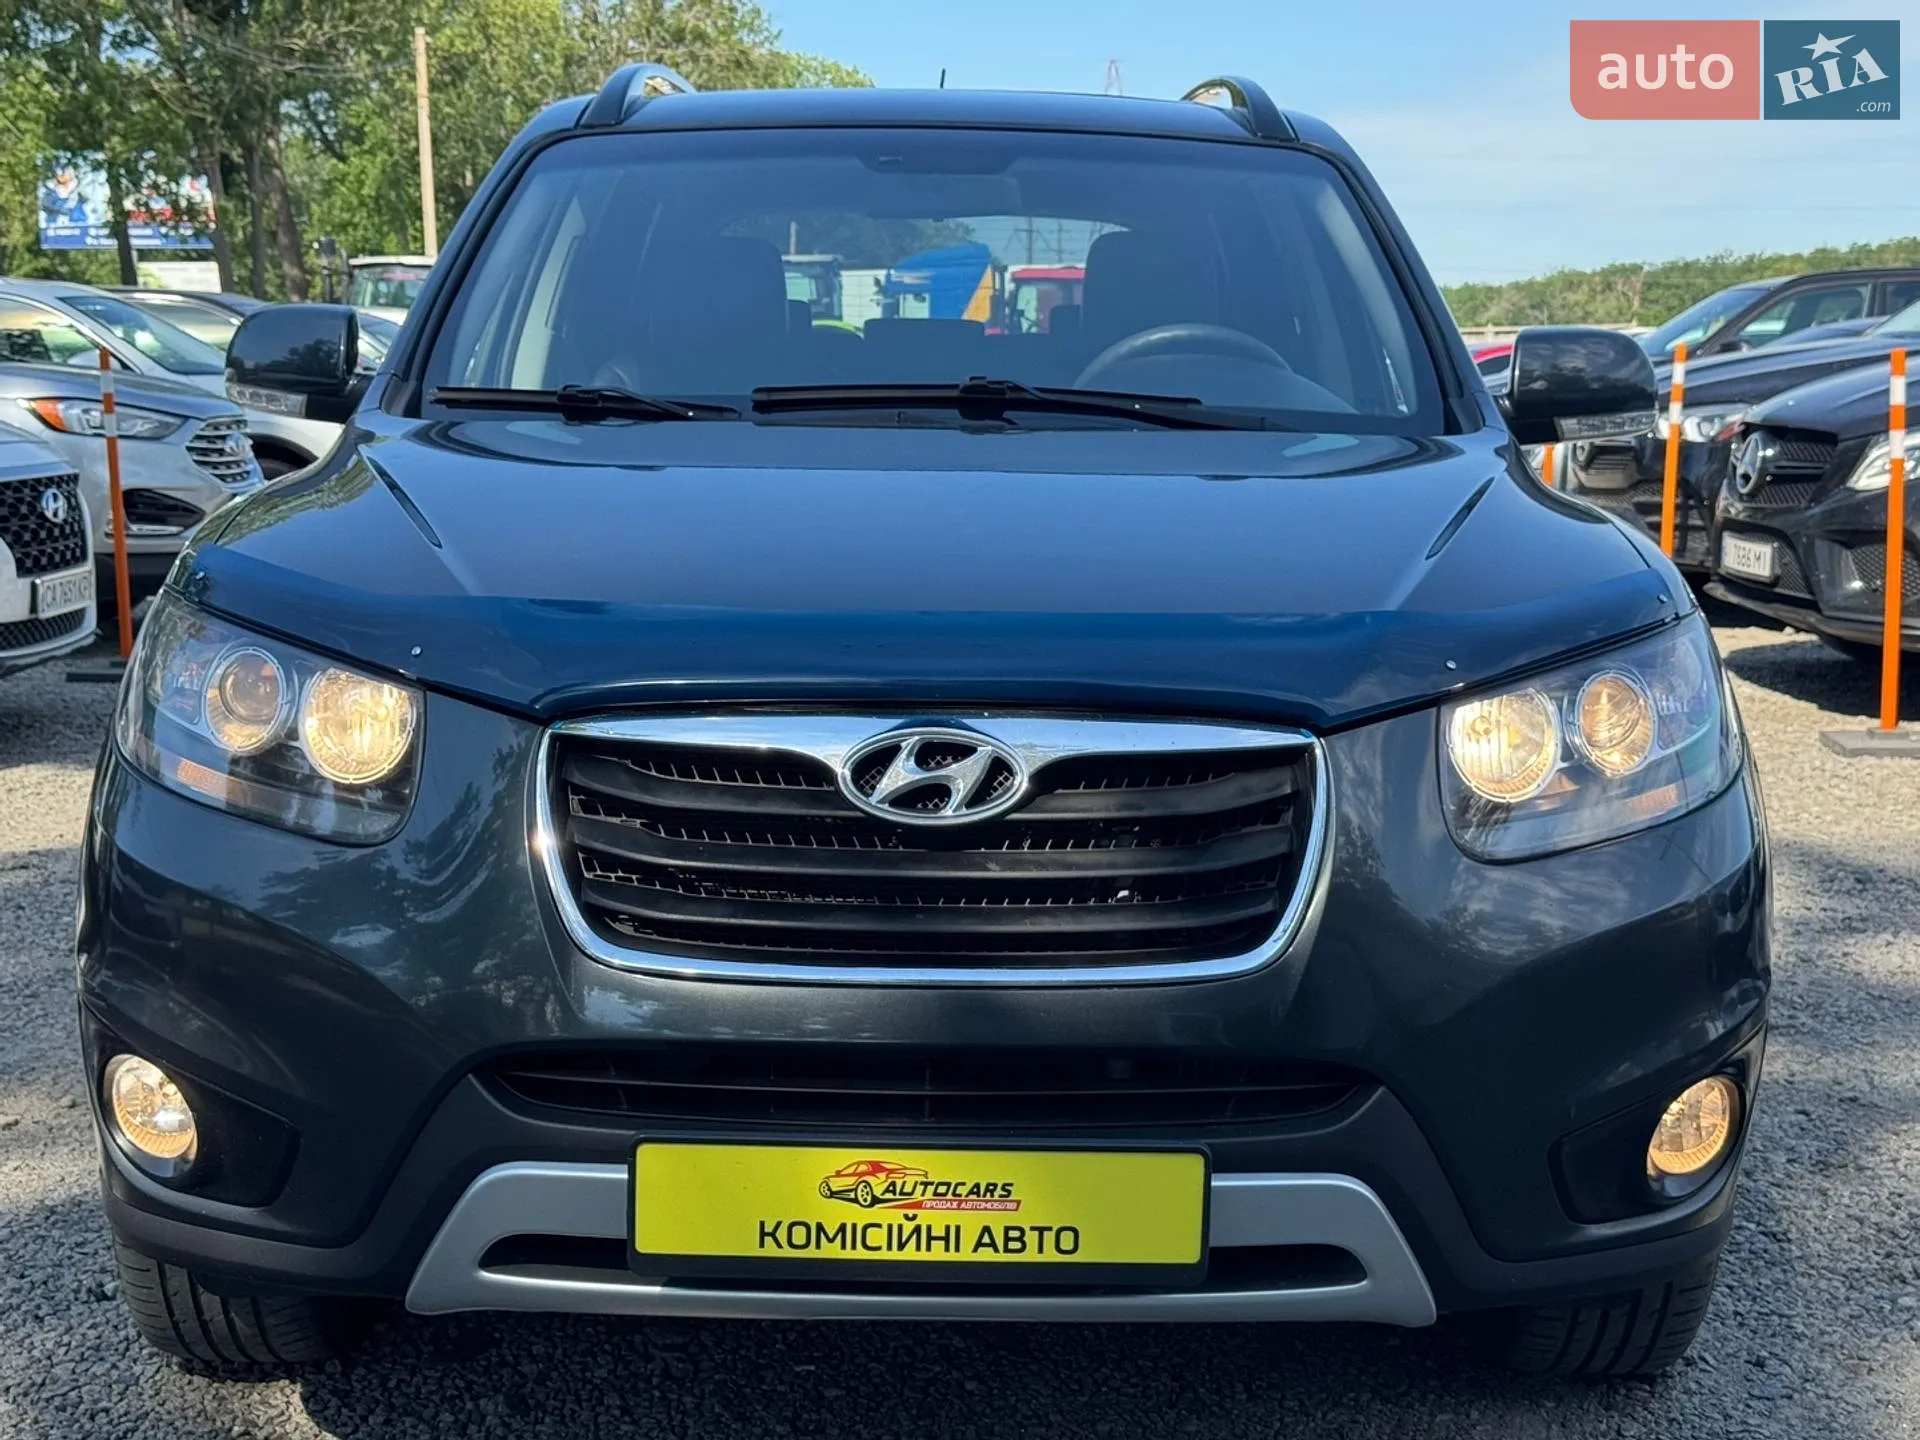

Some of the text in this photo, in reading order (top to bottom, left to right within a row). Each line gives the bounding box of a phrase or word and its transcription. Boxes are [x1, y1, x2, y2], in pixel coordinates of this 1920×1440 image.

[880, 1180, 1014, 1199] AUTOCARS
[921, 1200, 959, 1209] ПРОДАЖ
[758, 1213, 1080, 1255] КОМІСІЙНІ АВТО
